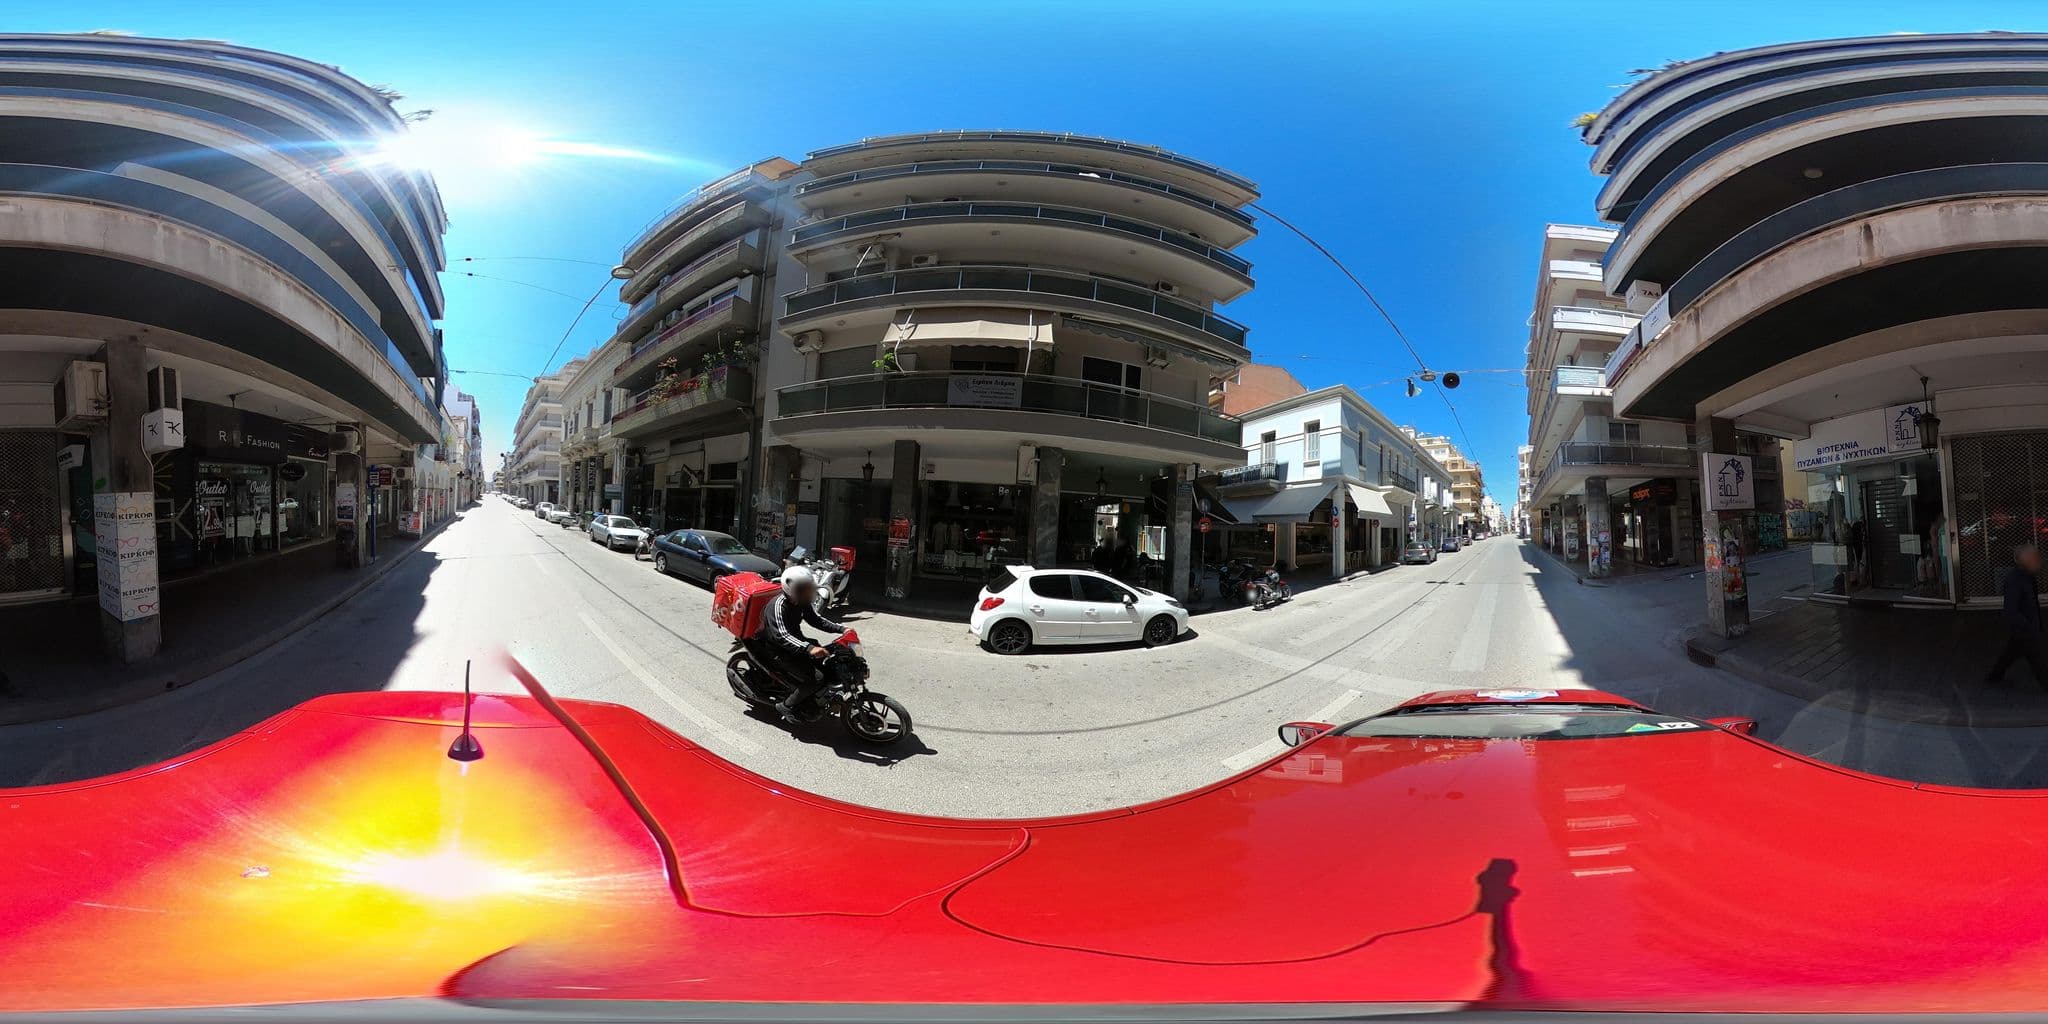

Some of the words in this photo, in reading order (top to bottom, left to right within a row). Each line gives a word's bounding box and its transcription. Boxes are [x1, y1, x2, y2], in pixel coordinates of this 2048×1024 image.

[1816, 440, 1860, 456] ΒΙΟΤΕΧΝΙΑ
[1797, 455, 1834, 469] ΠΥΖΑΜΩΝ
[1843, 446, 1887, 461] ΝΥΧΤΙΚΩΝ
[198, 480, 228, 495] Outlet
